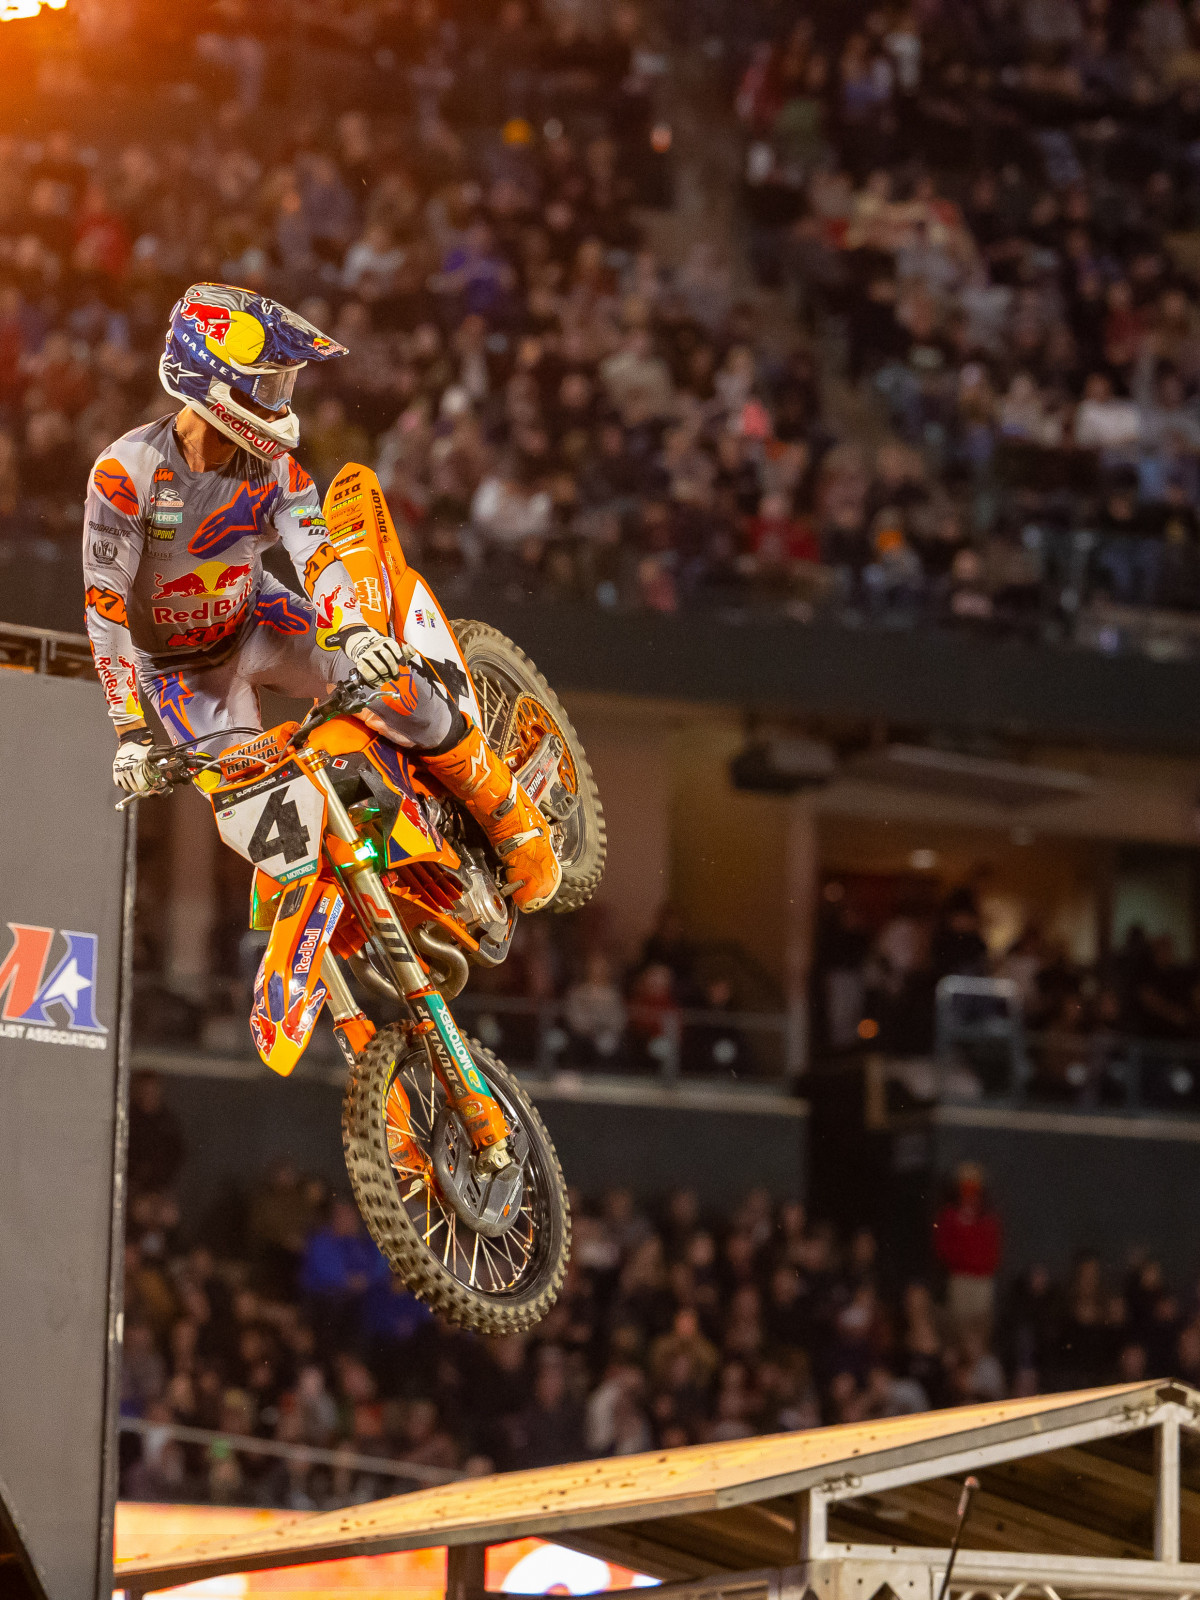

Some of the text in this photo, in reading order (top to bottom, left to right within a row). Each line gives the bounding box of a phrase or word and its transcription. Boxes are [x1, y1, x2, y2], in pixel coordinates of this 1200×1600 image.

[181, 332, 242, 382] OAKLEY
[210, 401, 279, 455] Red Bull
[333, 483, 361, 502] DID
[370, 488, 388, 534] DUNLOP
[152, 576, 253, 625] Red Bull
[99, 656, 124, 706] Red Bull
[226, 745, 282, 777] RENTHAL
[525, 770, 546, 798] ENTHAL
[247, 784, 311, 865] 4
[286, 863, 316, 880] MOTOREX
[293, 928, 322, 974] Red Bull
[24, 1026, 107, 1050] ASSOCIATION
[415, 1004, 459, 1082] DUNLP
[437, 1005, 473, 1071] MOTOREX
